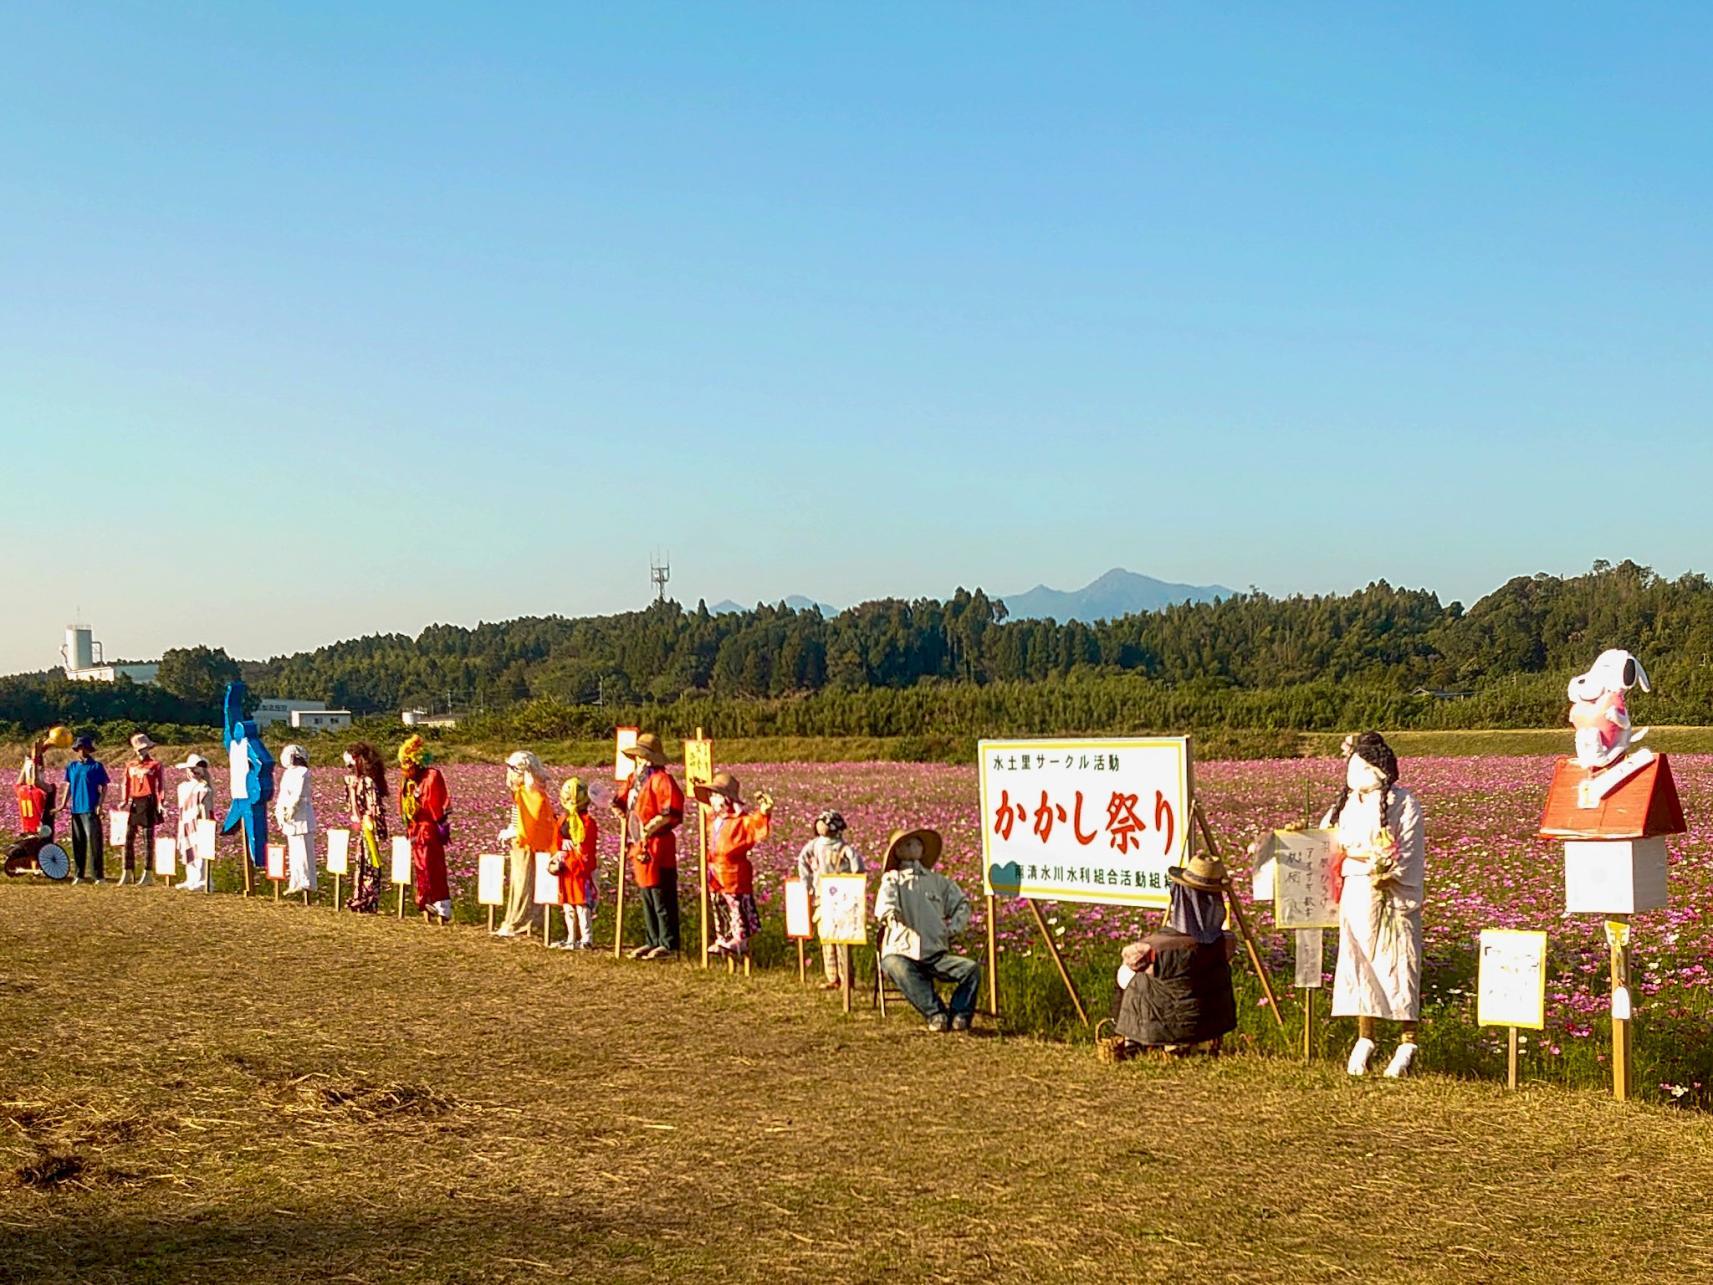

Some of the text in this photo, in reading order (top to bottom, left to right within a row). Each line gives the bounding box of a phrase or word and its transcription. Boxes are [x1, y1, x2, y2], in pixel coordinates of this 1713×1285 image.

[993, 754, 1120, 772] 水土里サークル活動
[993, 789, 1175, 856] かかし祭り
